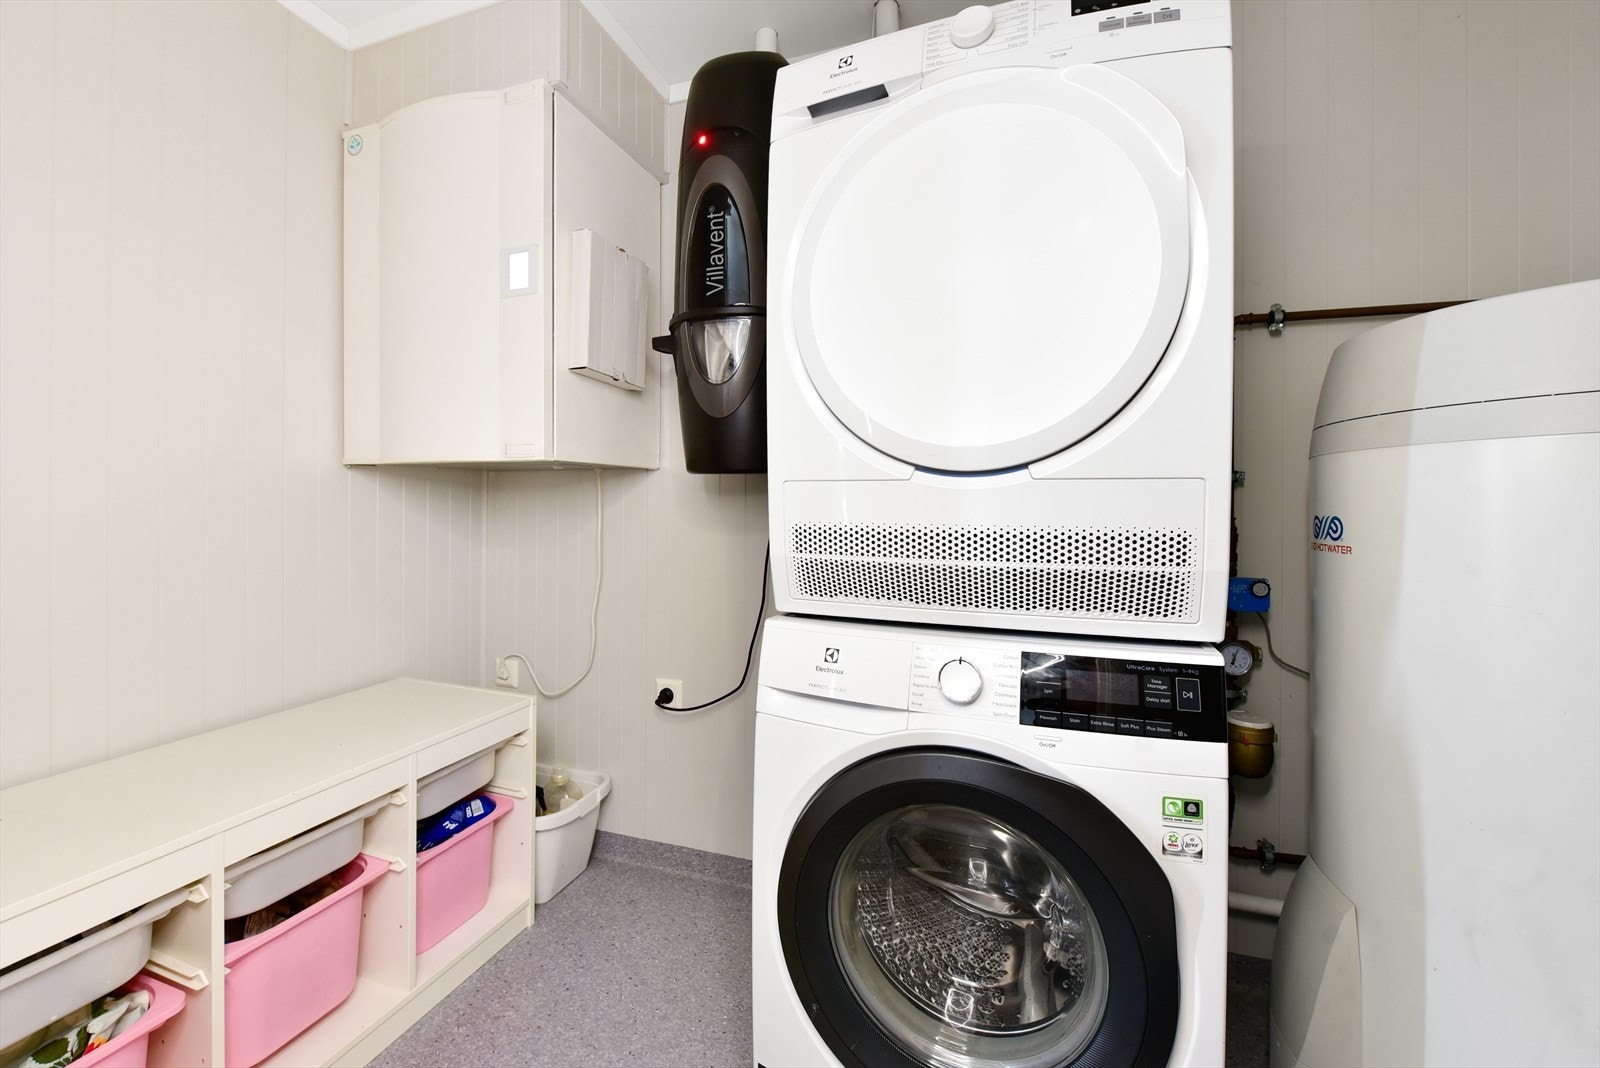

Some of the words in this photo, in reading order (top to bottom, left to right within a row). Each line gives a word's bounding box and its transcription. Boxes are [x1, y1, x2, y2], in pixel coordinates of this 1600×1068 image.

[829, 67, 858, 79] Electrolux
[706, 210, 725, 296] Villavent
[1317, 542, 1353, 555] HOTWATER
[815, 665, 844, 675] Electrolux
[1126, 664, 1156, 672] UltraCare
[1159, 666, 1179, 674] System
[1146, 696, 1159, 704] Delay
[1103, 720, 1115, 728] Rinse
[1038, 741, 1056, 749] On/Off
